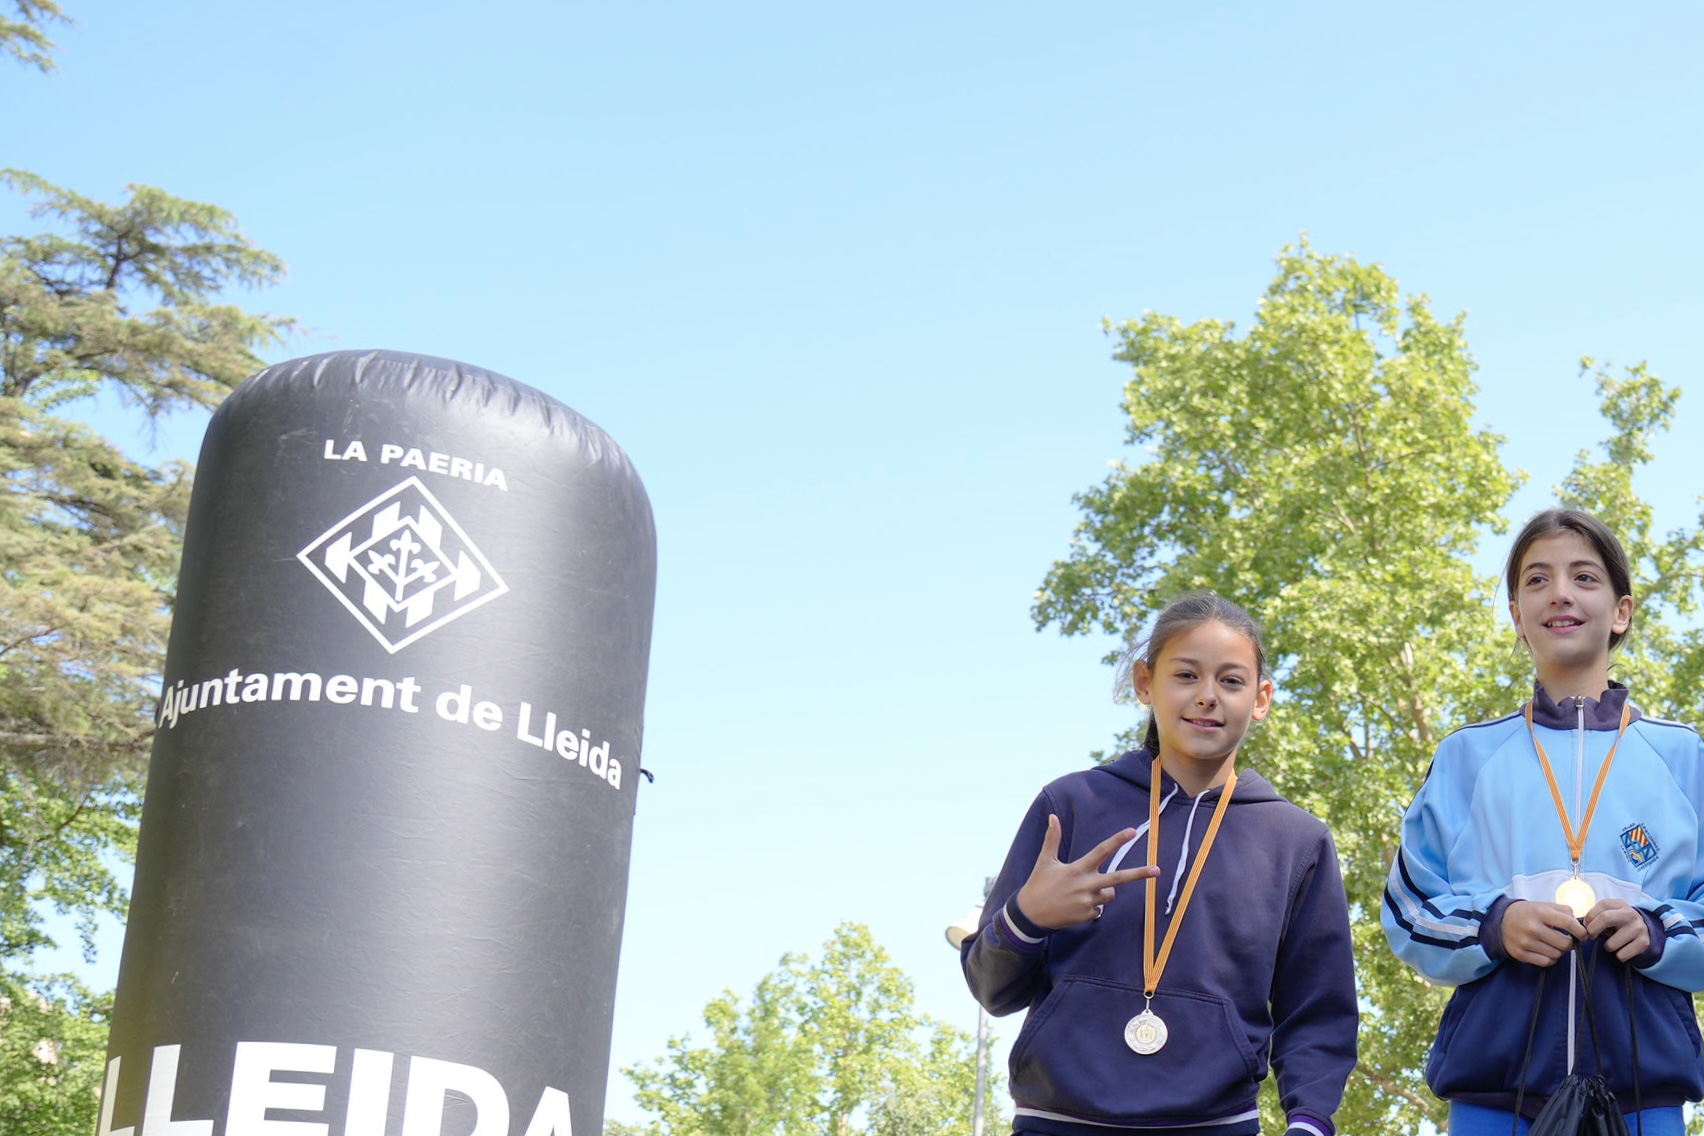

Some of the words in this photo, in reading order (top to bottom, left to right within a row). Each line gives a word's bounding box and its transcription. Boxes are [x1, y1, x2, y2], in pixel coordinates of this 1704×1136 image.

[323, 438, 368, 463] LA
[380, 443, 509, 492] PAERIA
[157, 667, 421, 729] Ajuntament
[435, 683, 503, 732] de
[516, 702, 624, 791] Lleida
